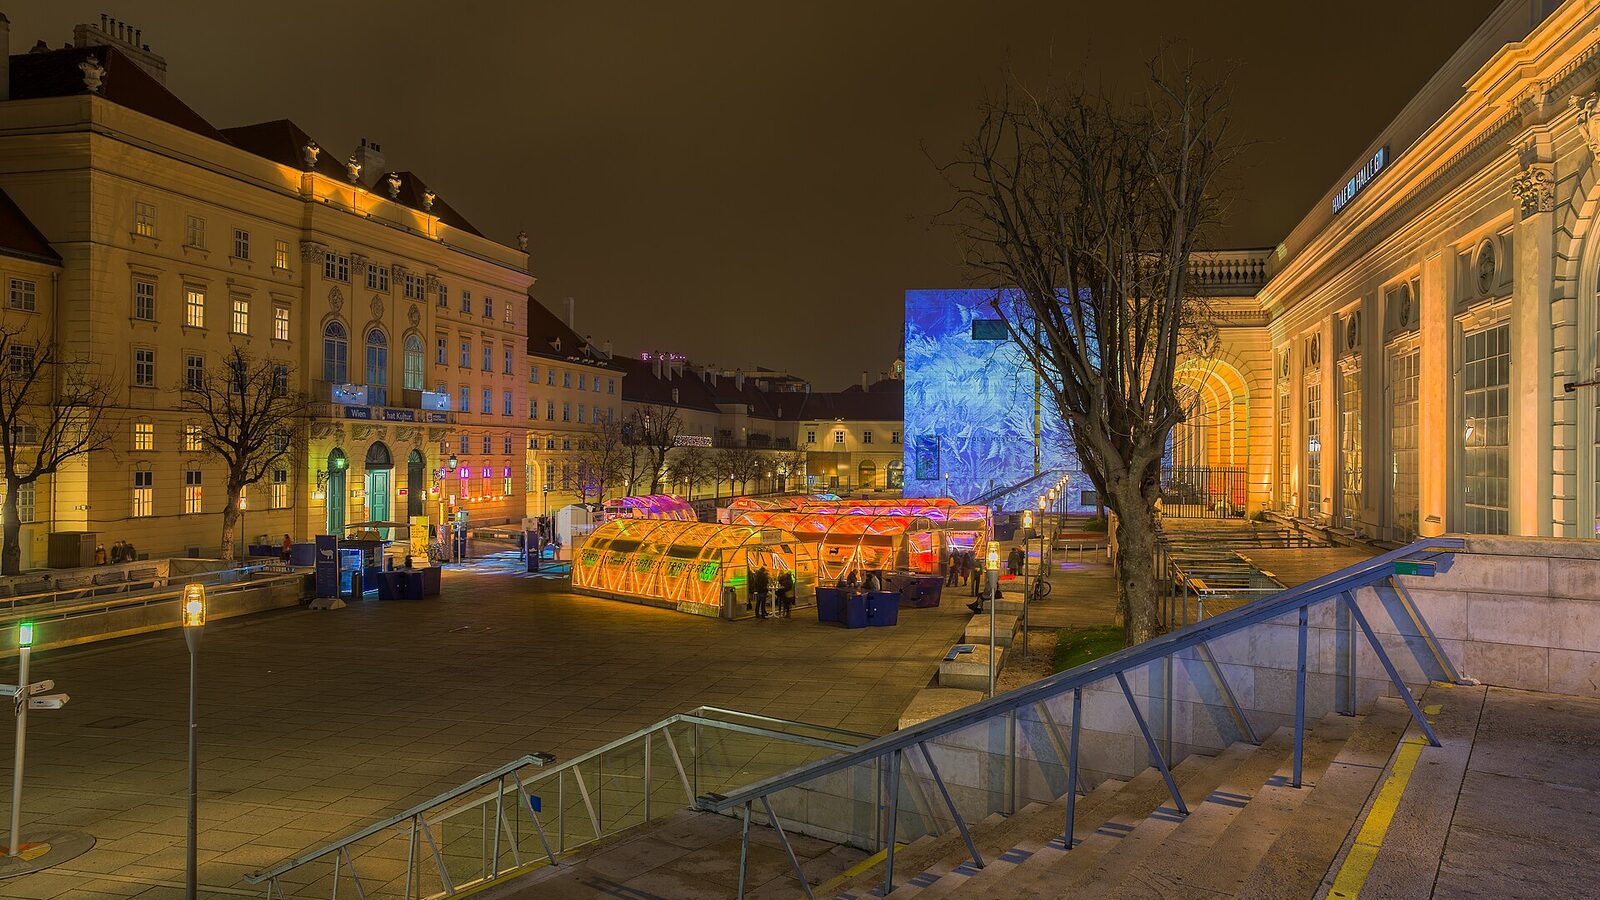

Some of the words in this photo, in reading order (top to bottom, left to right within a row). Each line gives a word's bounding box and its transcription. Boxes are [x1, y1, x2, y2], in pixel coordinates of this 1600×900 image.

[1356, 158, 1374, 191] HALLE
[351, 409, 367, 418] Wien
[386, 411, 396, 420] hat
